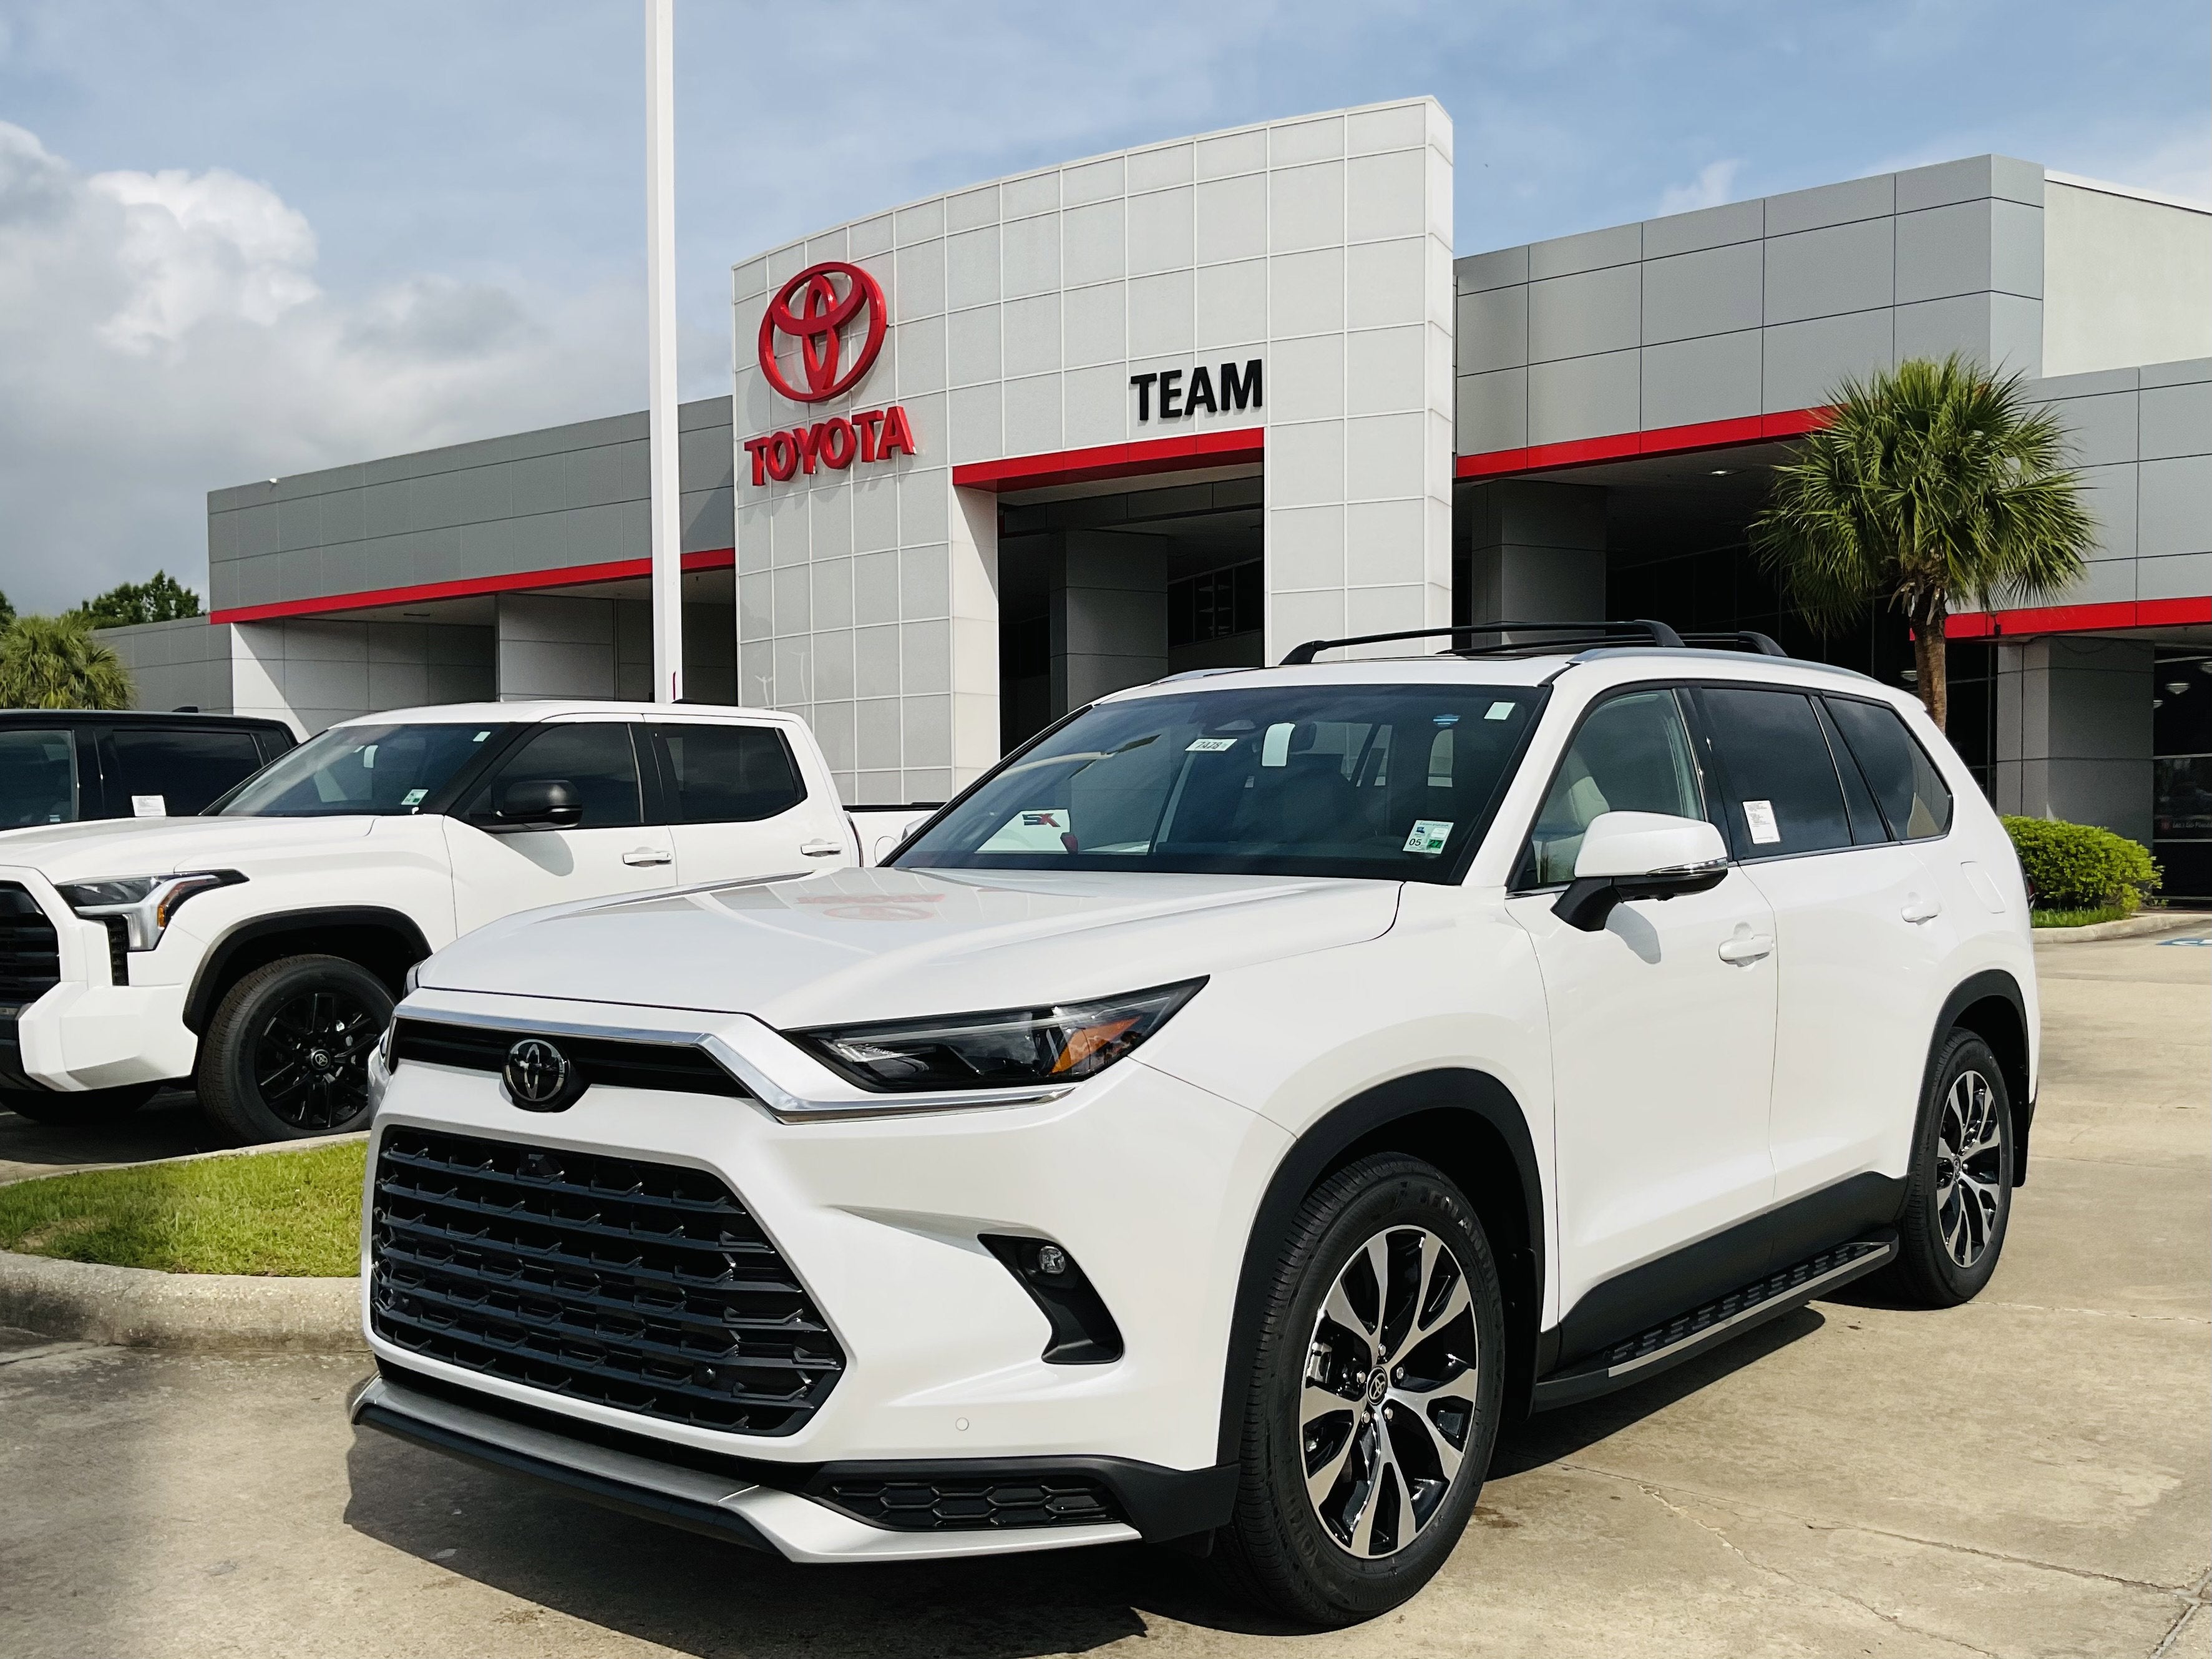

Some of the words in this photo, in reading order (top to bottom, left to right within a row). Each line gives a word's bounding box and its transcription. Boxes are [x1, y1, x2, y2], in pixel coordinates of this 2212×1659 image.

[1131, 359, 1262, 421] TEAM
[744, 406, 917, 486] TOYOTA
[1409, 838, 1422, 846] 05
[1427, 839, 1443, 849] 27
